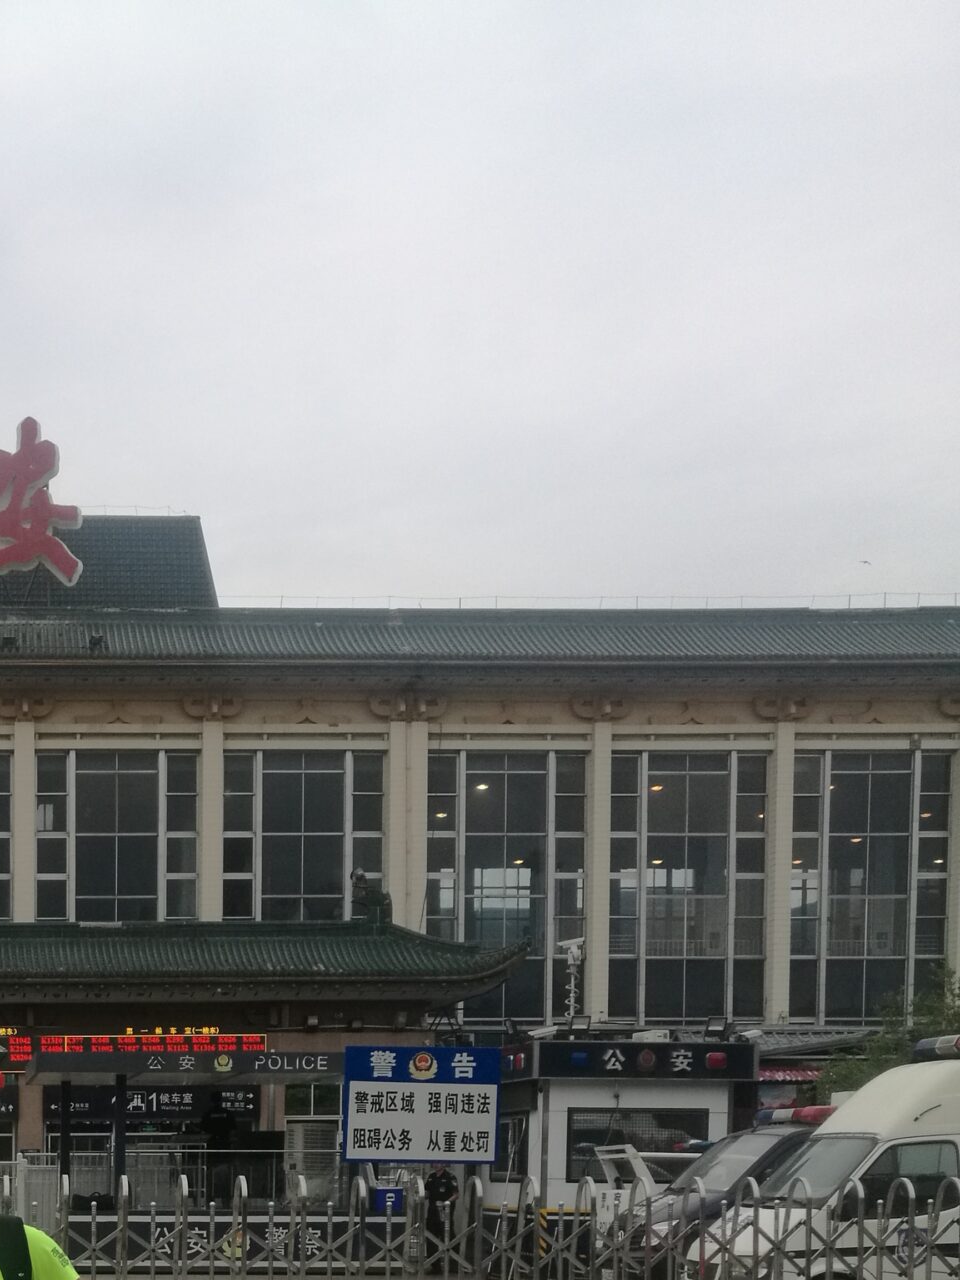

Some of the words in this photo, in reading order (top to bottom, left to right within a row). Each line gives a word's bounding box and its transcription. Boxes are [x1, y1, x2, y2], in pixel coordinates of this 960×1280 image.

[147, 1055, 195, 1071] 公安
[254, 1055, 328, 1070] POLICE
[370, 1050, 477, 1078] 警告
[601, 1049, 693, 1071] 公安
[148, 1092, 157, 1112] 1
[160, 1092, 193, 1104] 候车室
[354, 1091, 415, 1114] 警戒区域
[428, 1092, 491, 1115] 强闯违法
[352, 1128, 413, 1151] 阻碍公务
[426, 1130, 490, 1153] 从重处罚
